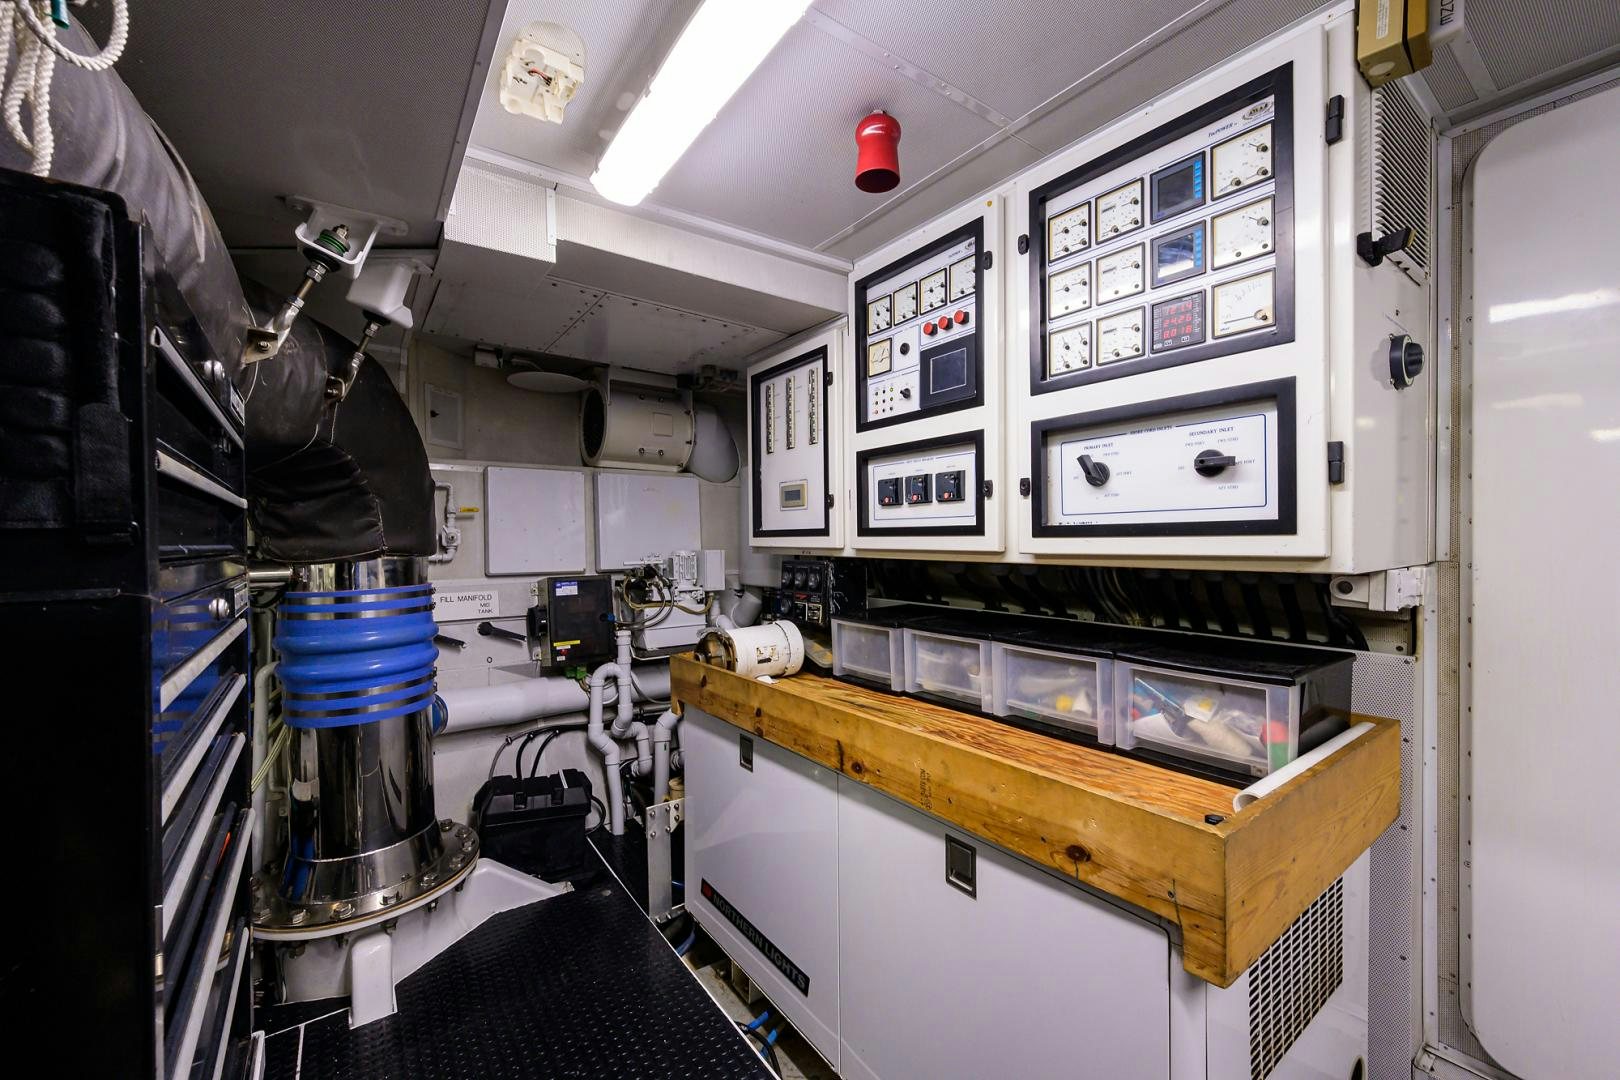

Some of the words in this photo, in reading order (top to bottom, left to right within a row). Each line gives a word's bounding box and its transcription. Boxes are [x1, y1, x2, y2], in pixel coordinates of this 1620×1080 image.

[457, 594, 492, 602] MANIFOLD
[713, 892, 763, 948] NORTHERN
[764, 942, 806, 990] LIGHTS
